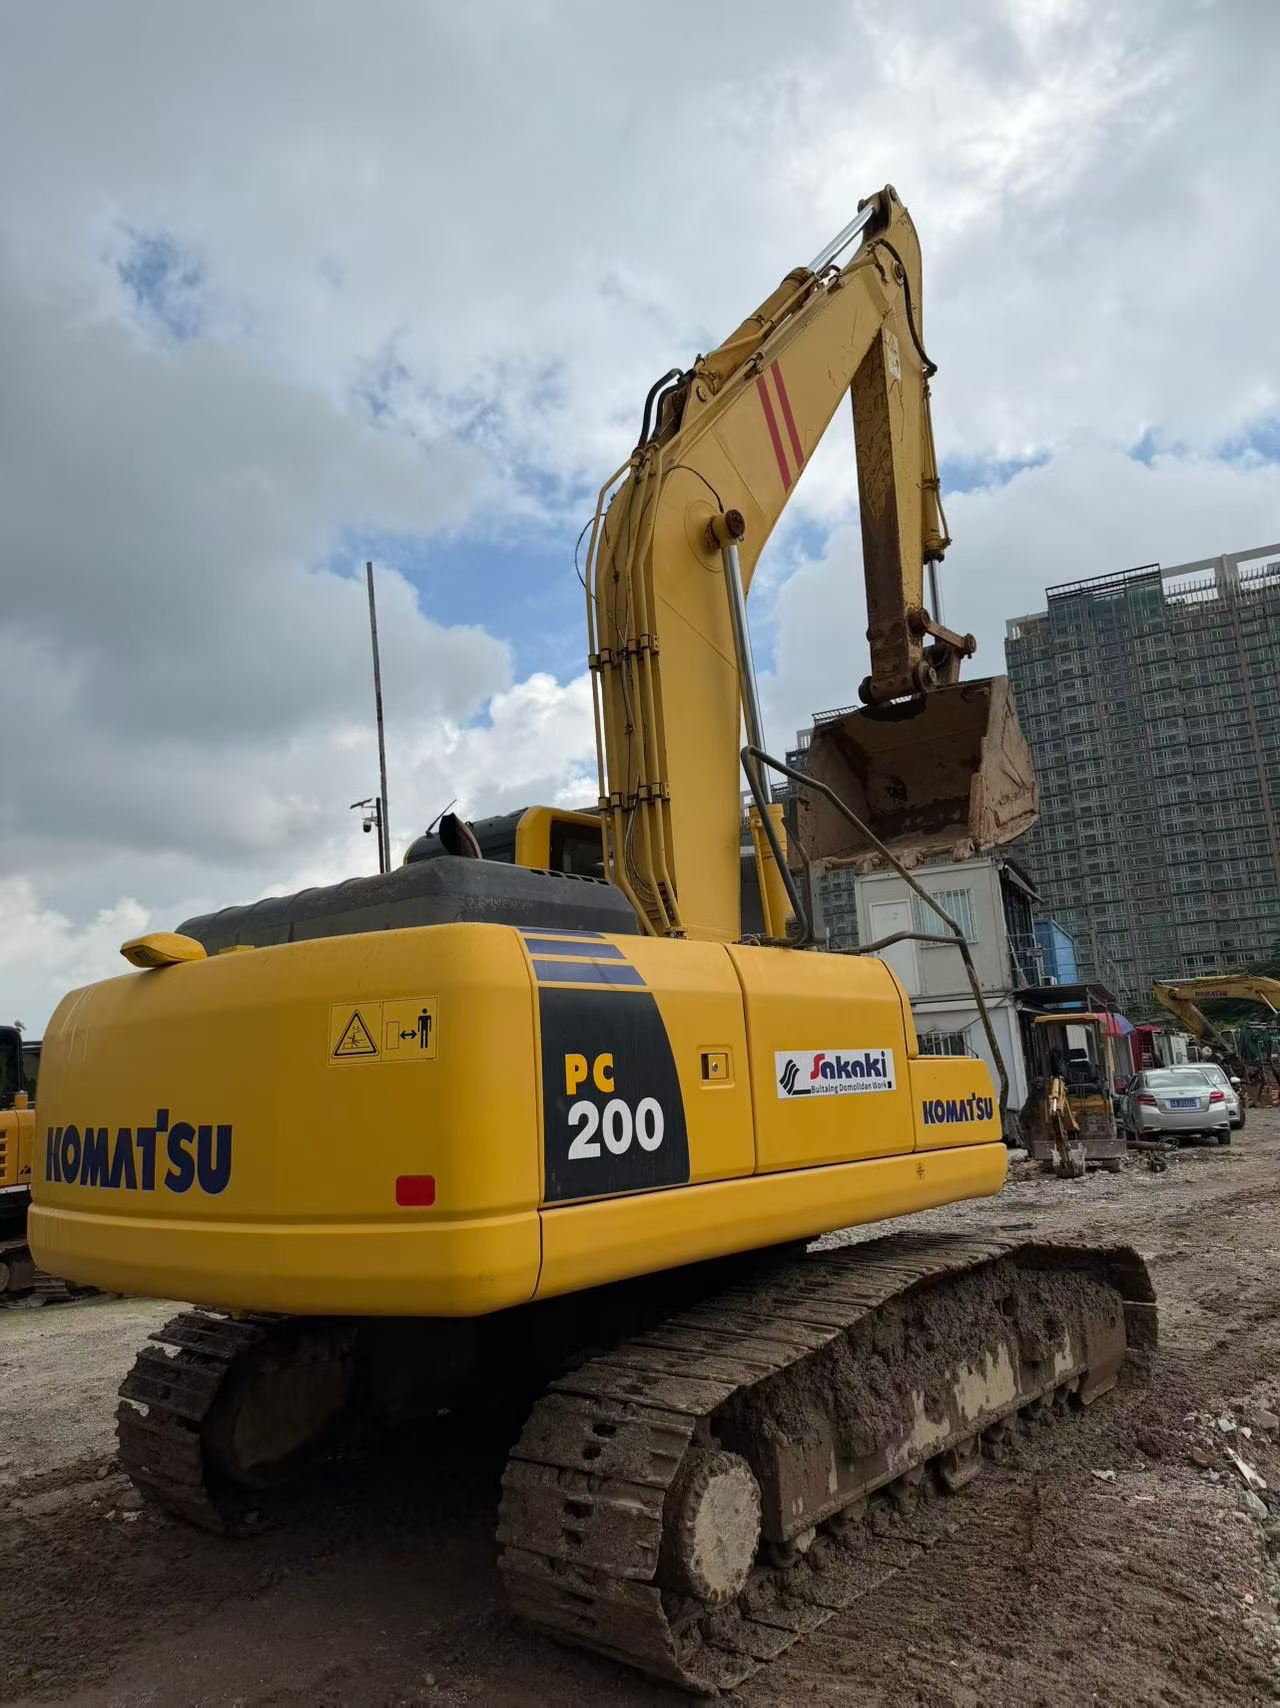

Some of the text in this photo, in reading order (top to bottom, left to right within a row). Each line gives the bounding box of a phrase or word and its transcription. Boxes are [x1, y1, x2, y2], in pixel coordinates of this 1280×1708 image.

[565, 1053, 615, 1095] PC
[810, 1051, 887, 1080] Sakaki
[872, 1080, 887, 1089] Work
[922, 1092, 993, 1124] KOMATSU
[567, 1097, 665, 1160] 200
[46, 1108, 232, 1194] KOMATSU
